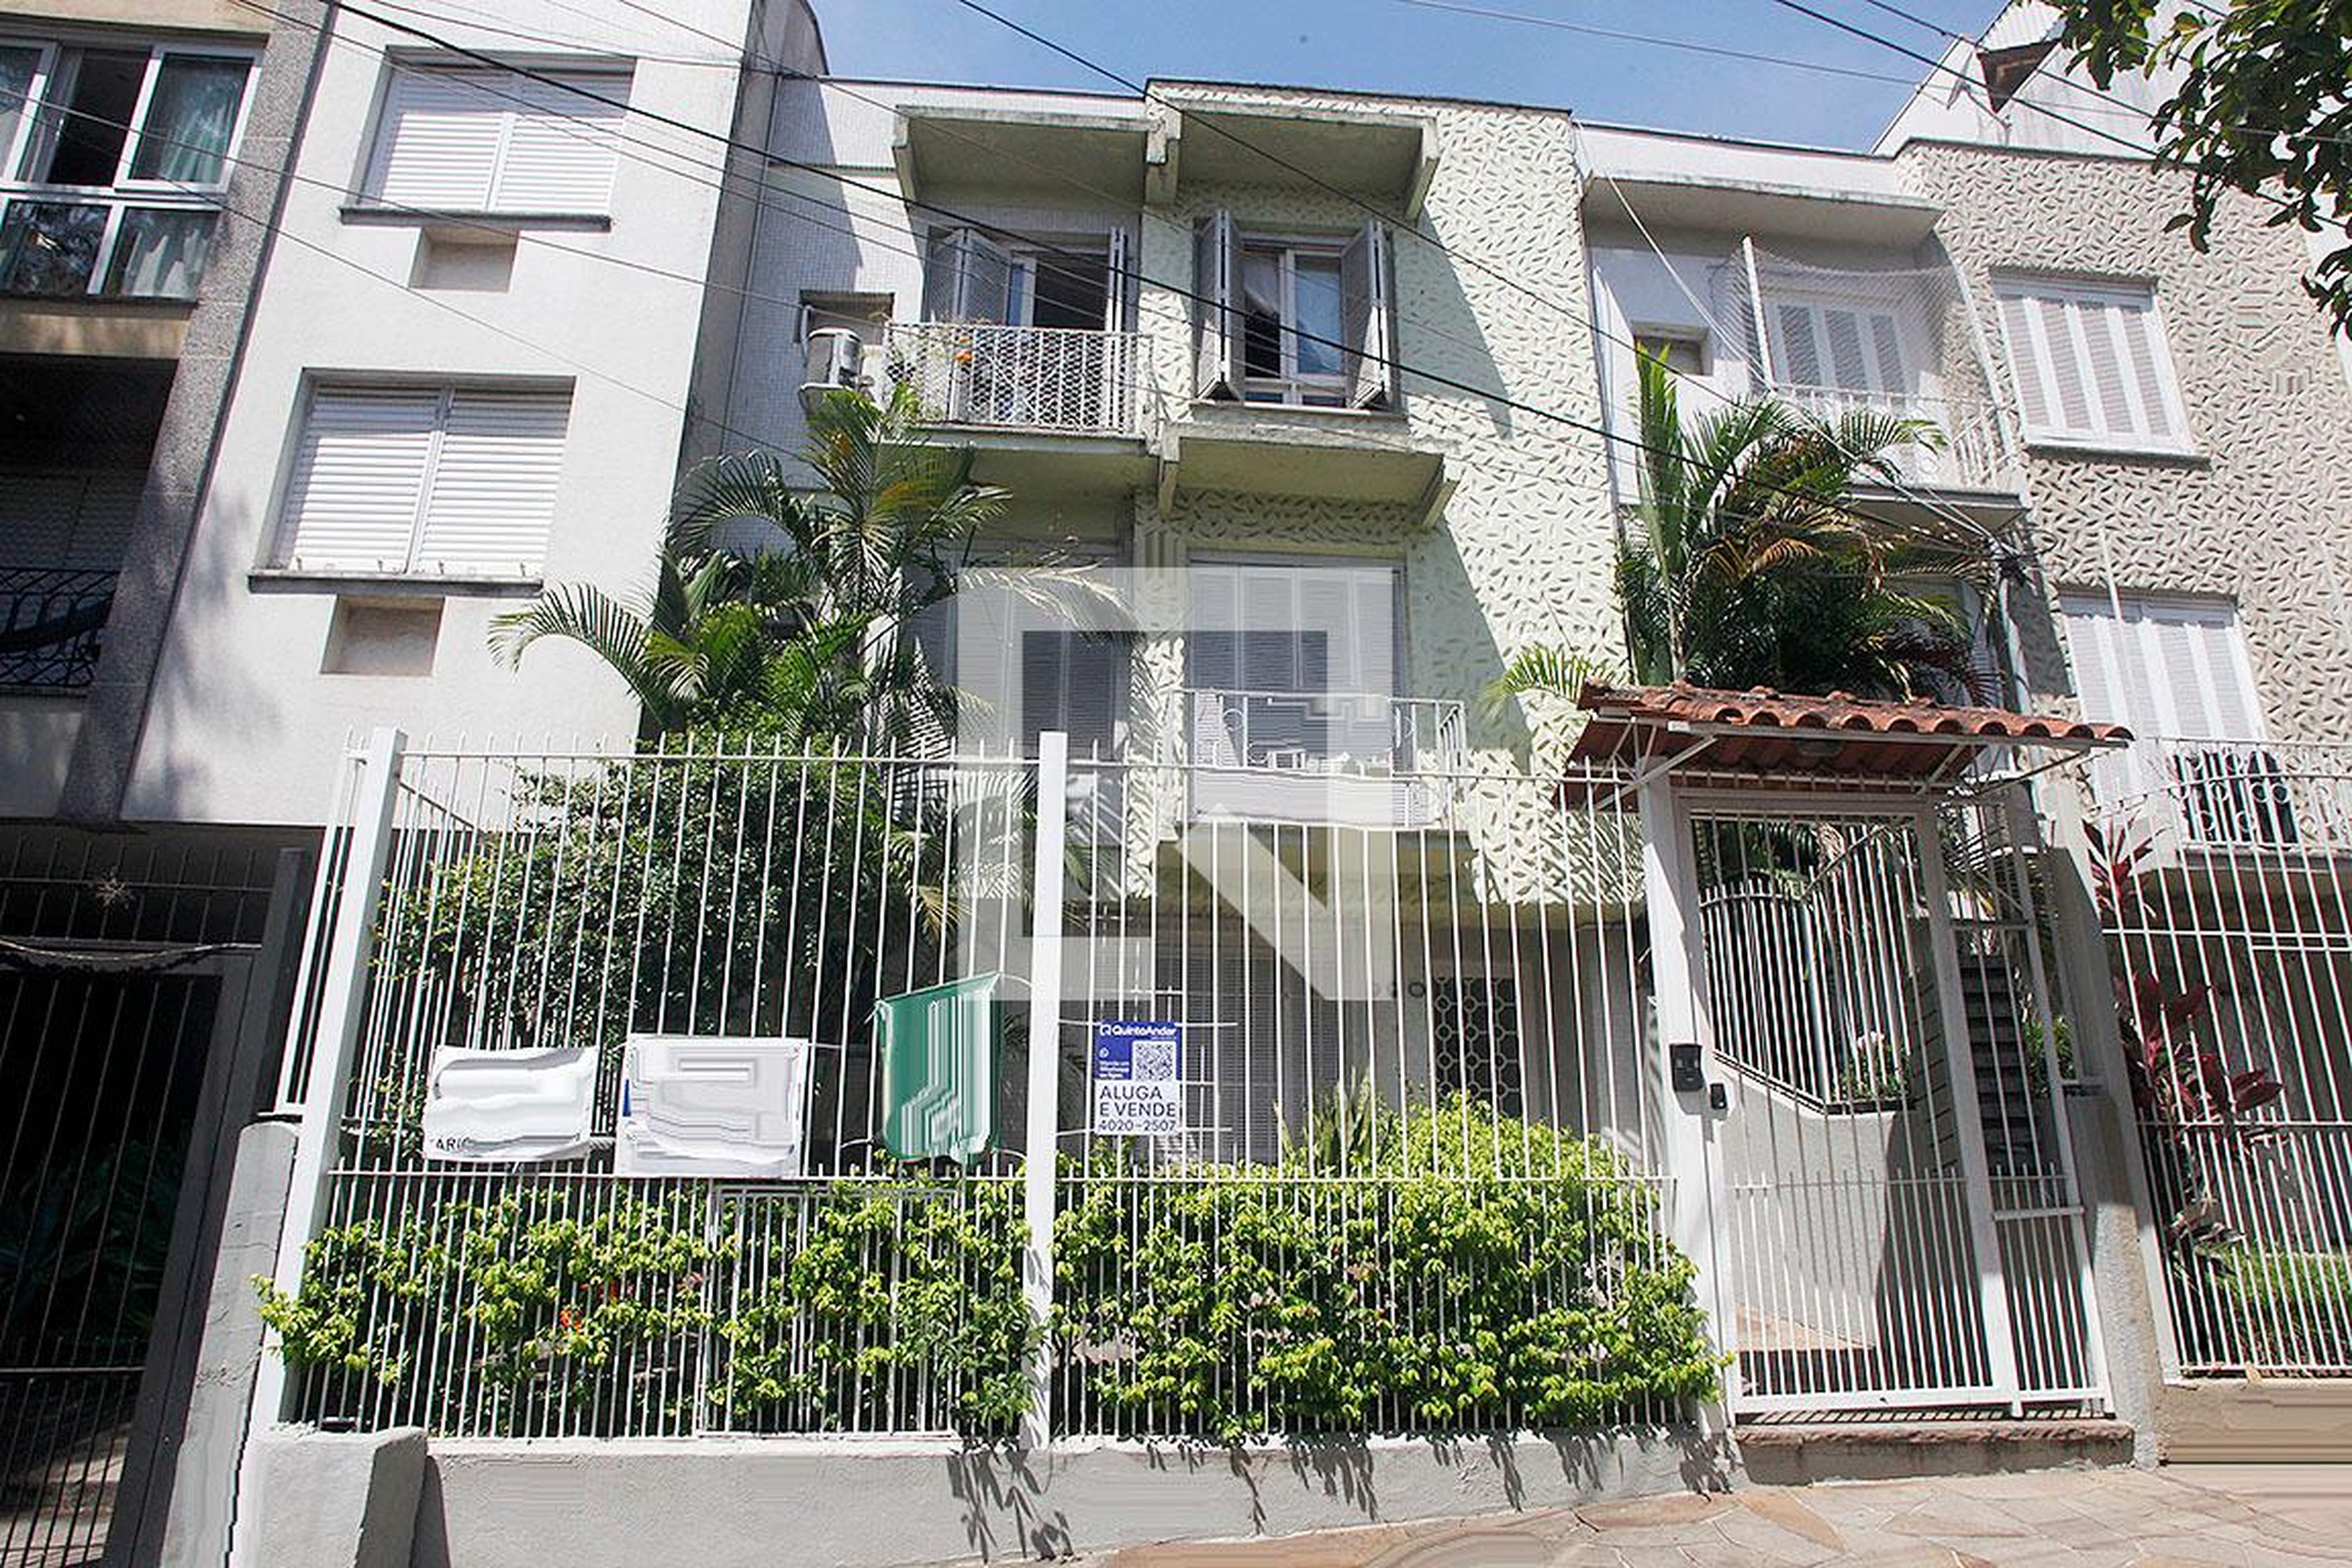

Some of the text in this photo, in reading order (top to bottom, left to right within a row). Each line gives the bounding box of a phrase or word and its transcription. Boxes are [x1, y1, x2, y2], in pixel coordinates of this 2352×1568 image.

[1112, 1024, 1177, 1036] QuintoAndar
[1099, 1085, 1163, 1101] ALUGA
[1100, 1102, 1175, 1117] E VENDE
[1099, 1118, 1176, 1131] 4020-2507
